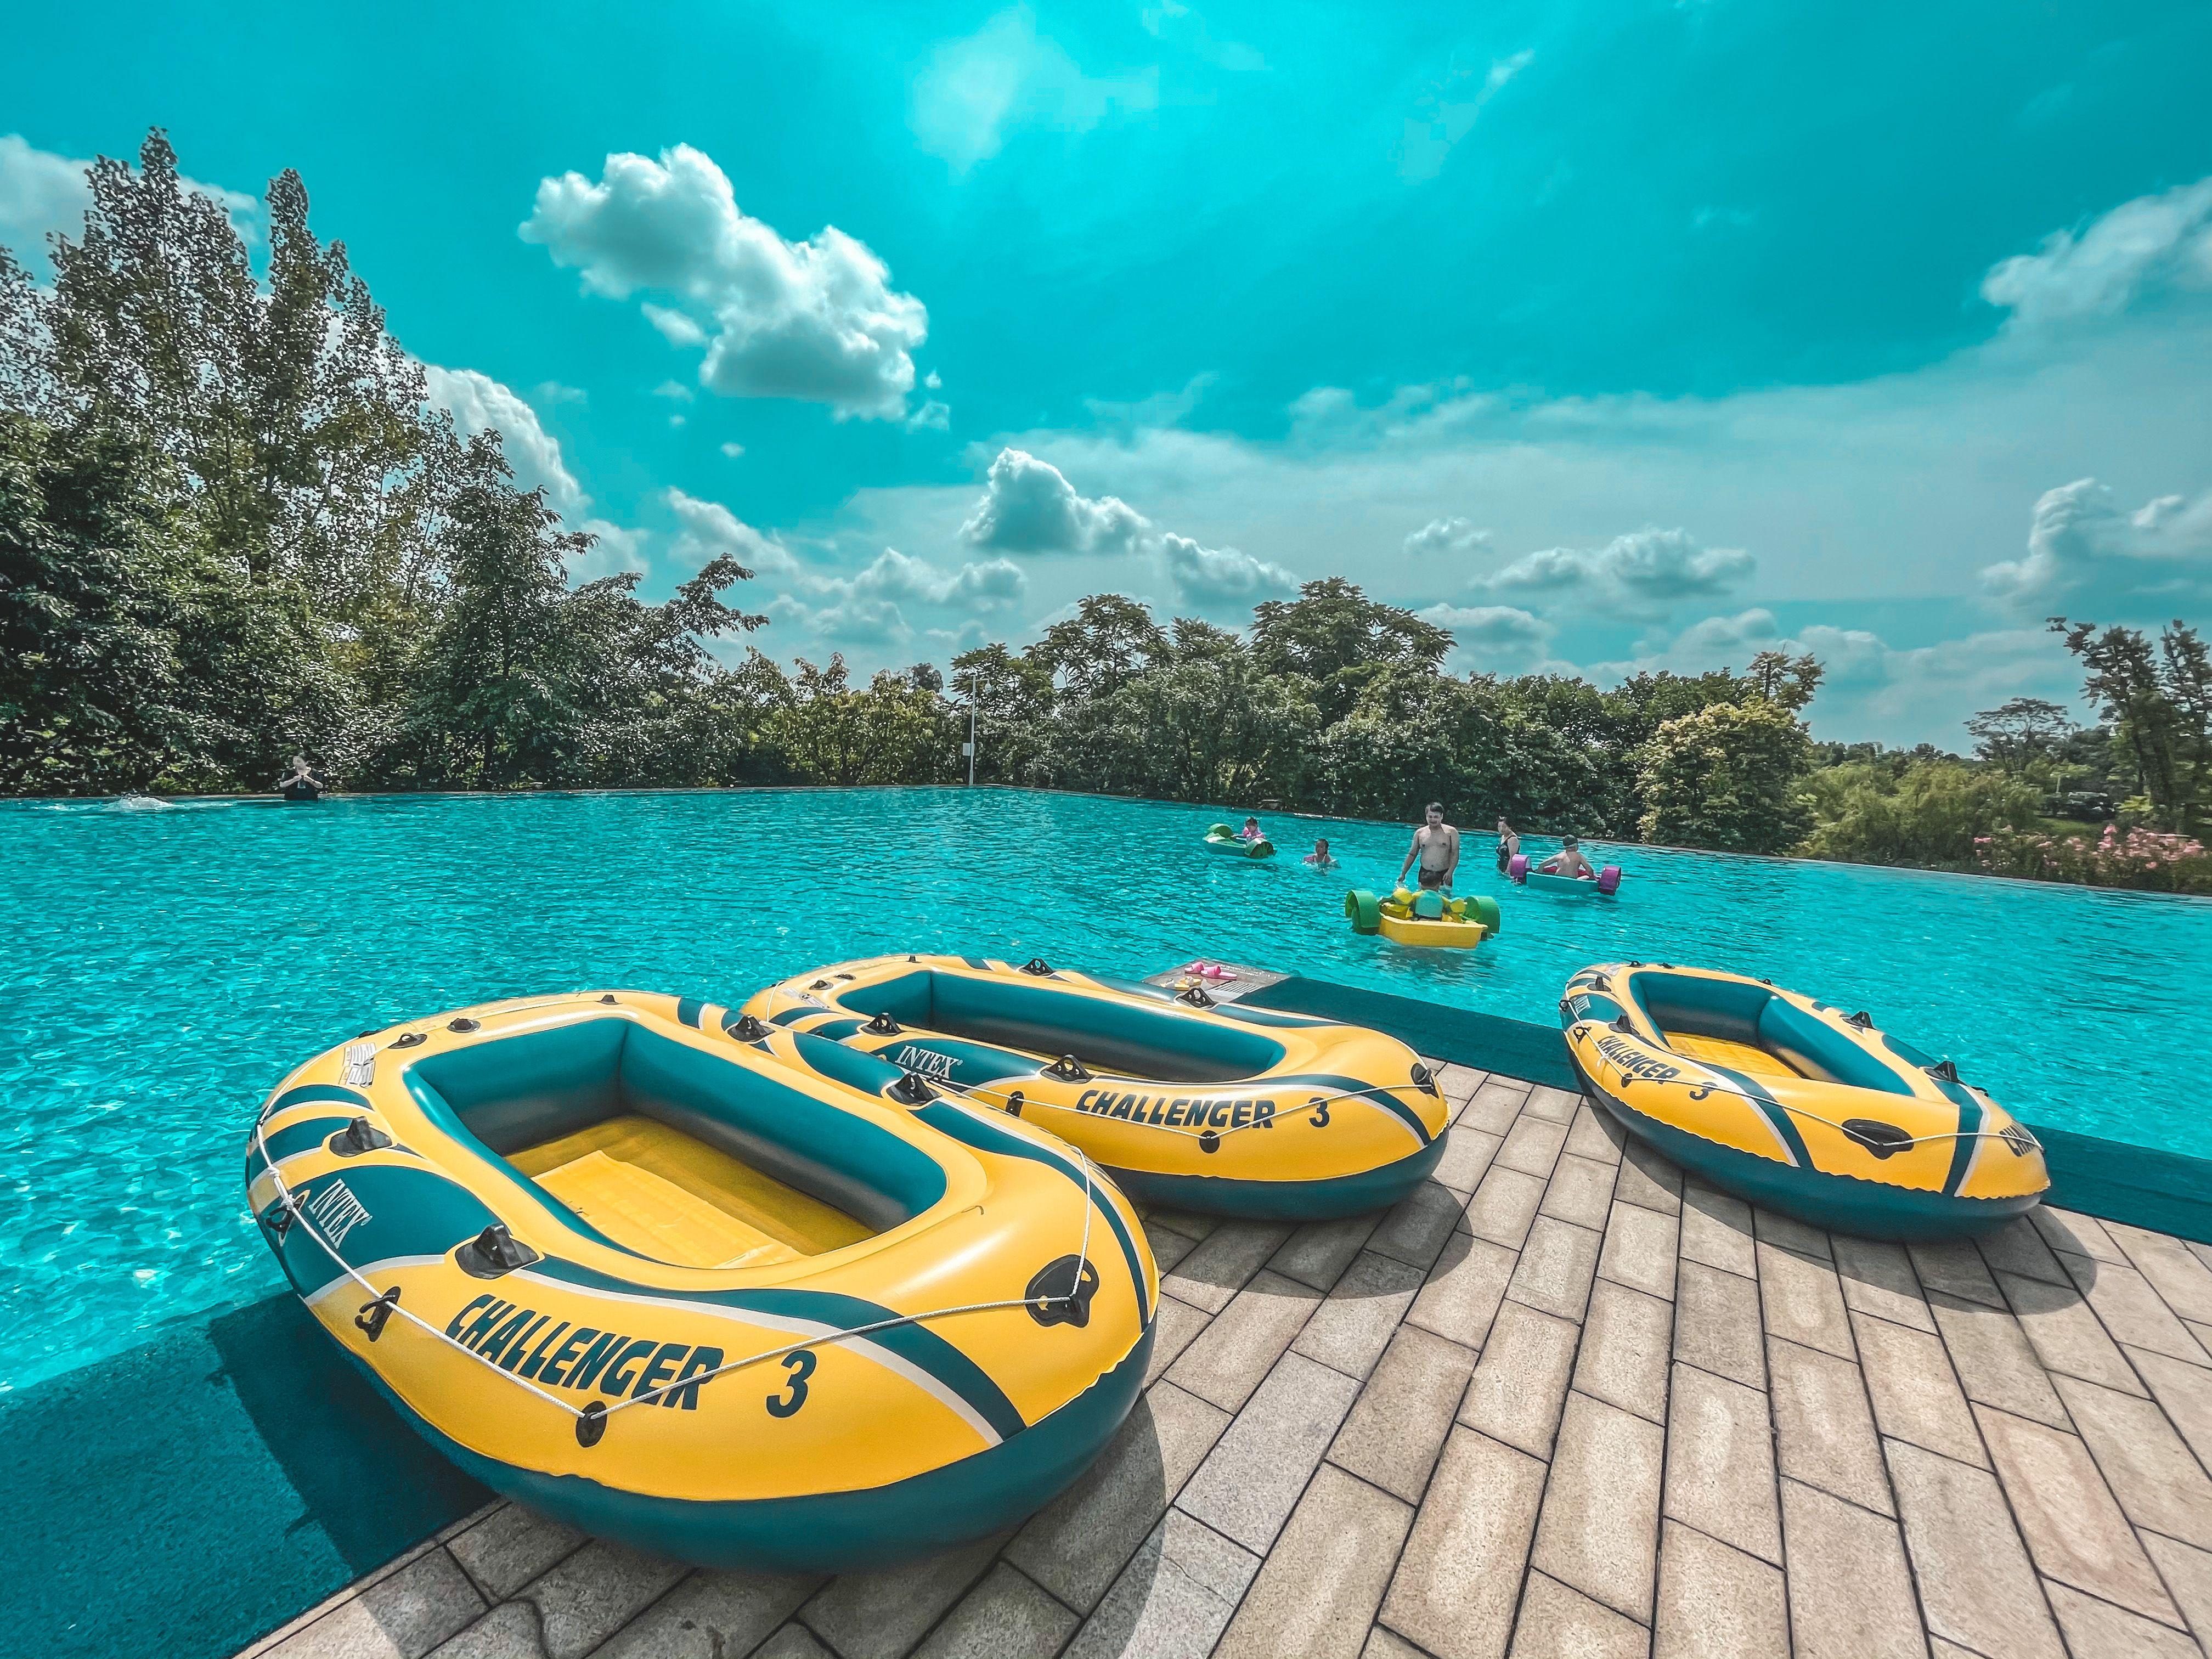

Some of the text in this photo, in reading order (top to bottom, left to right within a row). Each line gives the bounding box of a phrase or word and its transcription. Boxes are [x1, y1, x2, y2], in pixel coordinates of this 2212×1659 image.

[895, 1045, 960, 1079] INTEX
[1598, 1035, 1718, 1101] CHALLENGER 3
[1076, 1090, 1330, 1128] CHALLENGER 3
[308, 1178, 370, 1250] INTEX
[445, 1294, 817, 1419] CHALLENGER 3
